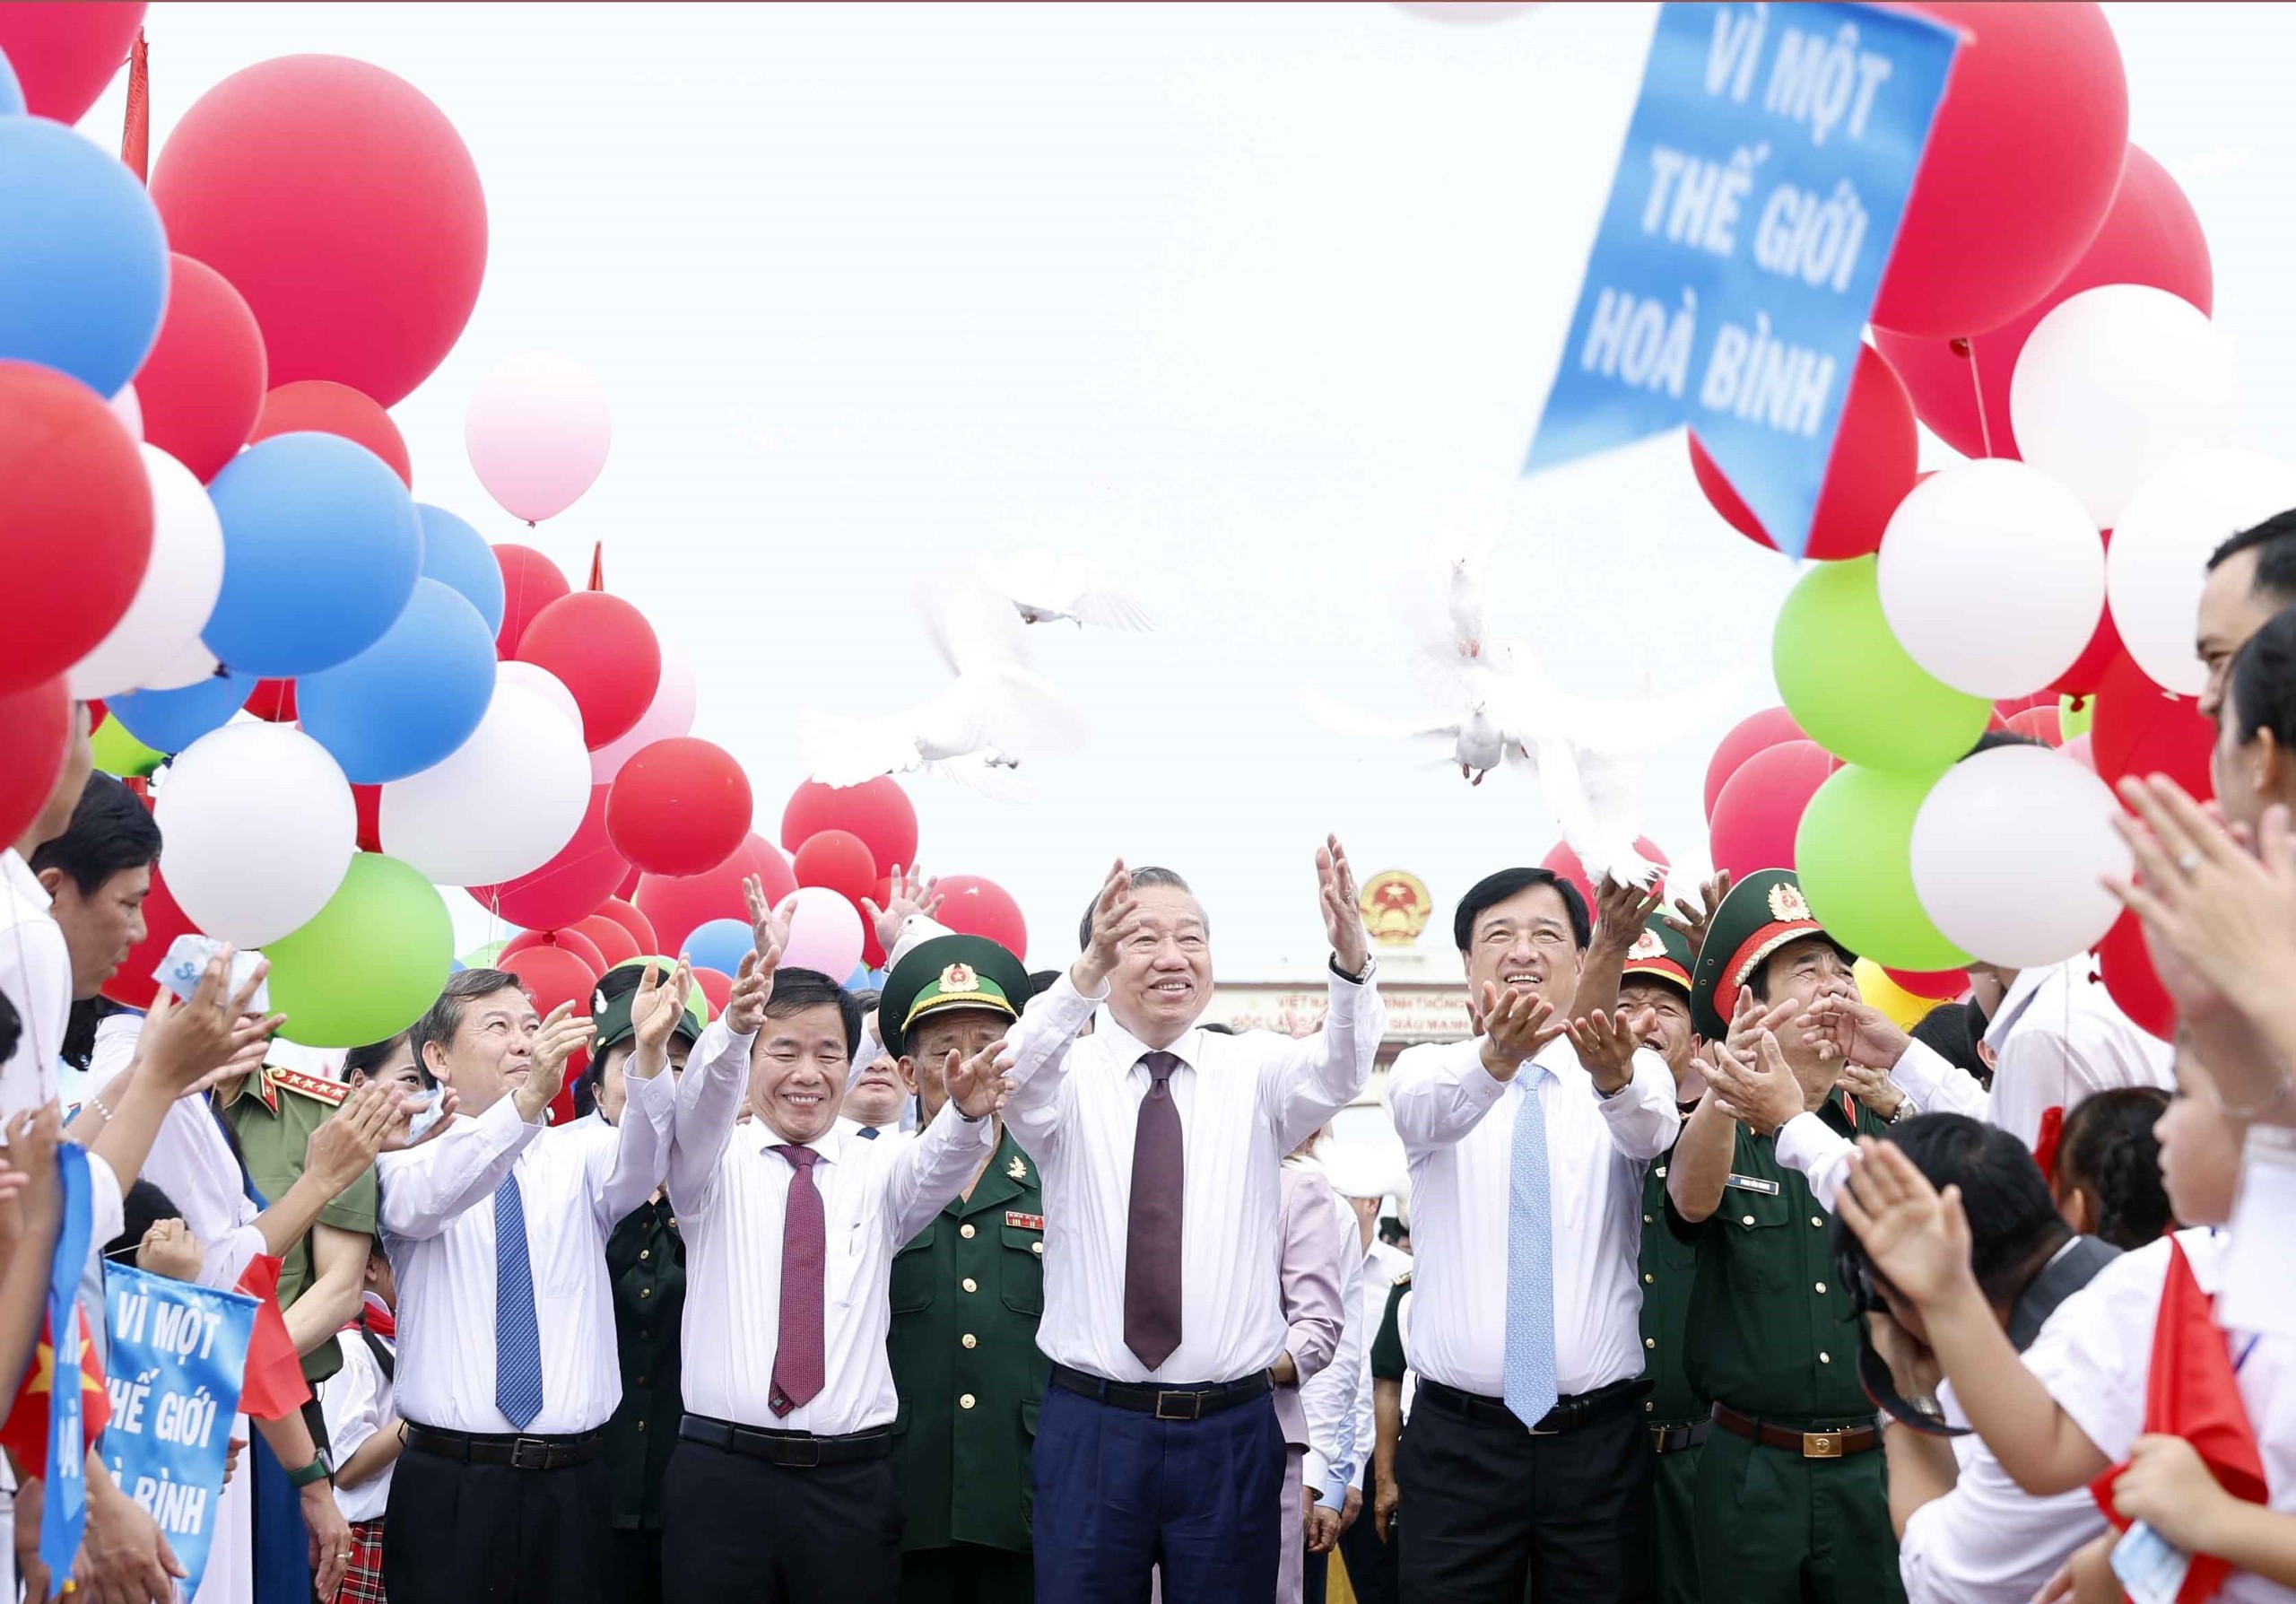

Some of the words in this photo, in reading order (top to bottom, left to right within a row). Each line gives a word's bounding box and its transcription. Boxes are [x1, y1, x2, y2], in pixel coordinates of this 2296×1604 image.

[1764, 22, 1893, 148] MỘT
[1641, 141, 1772, 258] THẾ
[1753, 179, 1869, 293] GIỚI
[1581, 286, 1698, 399] HOÀ
[1700, 309, 1836, 438] BÌNH
[117, 1282, 149, 1344] VÌ
[152, 1296, 222, 1366] MỘT
[155, 1385, 218, 1449] GIỚI
